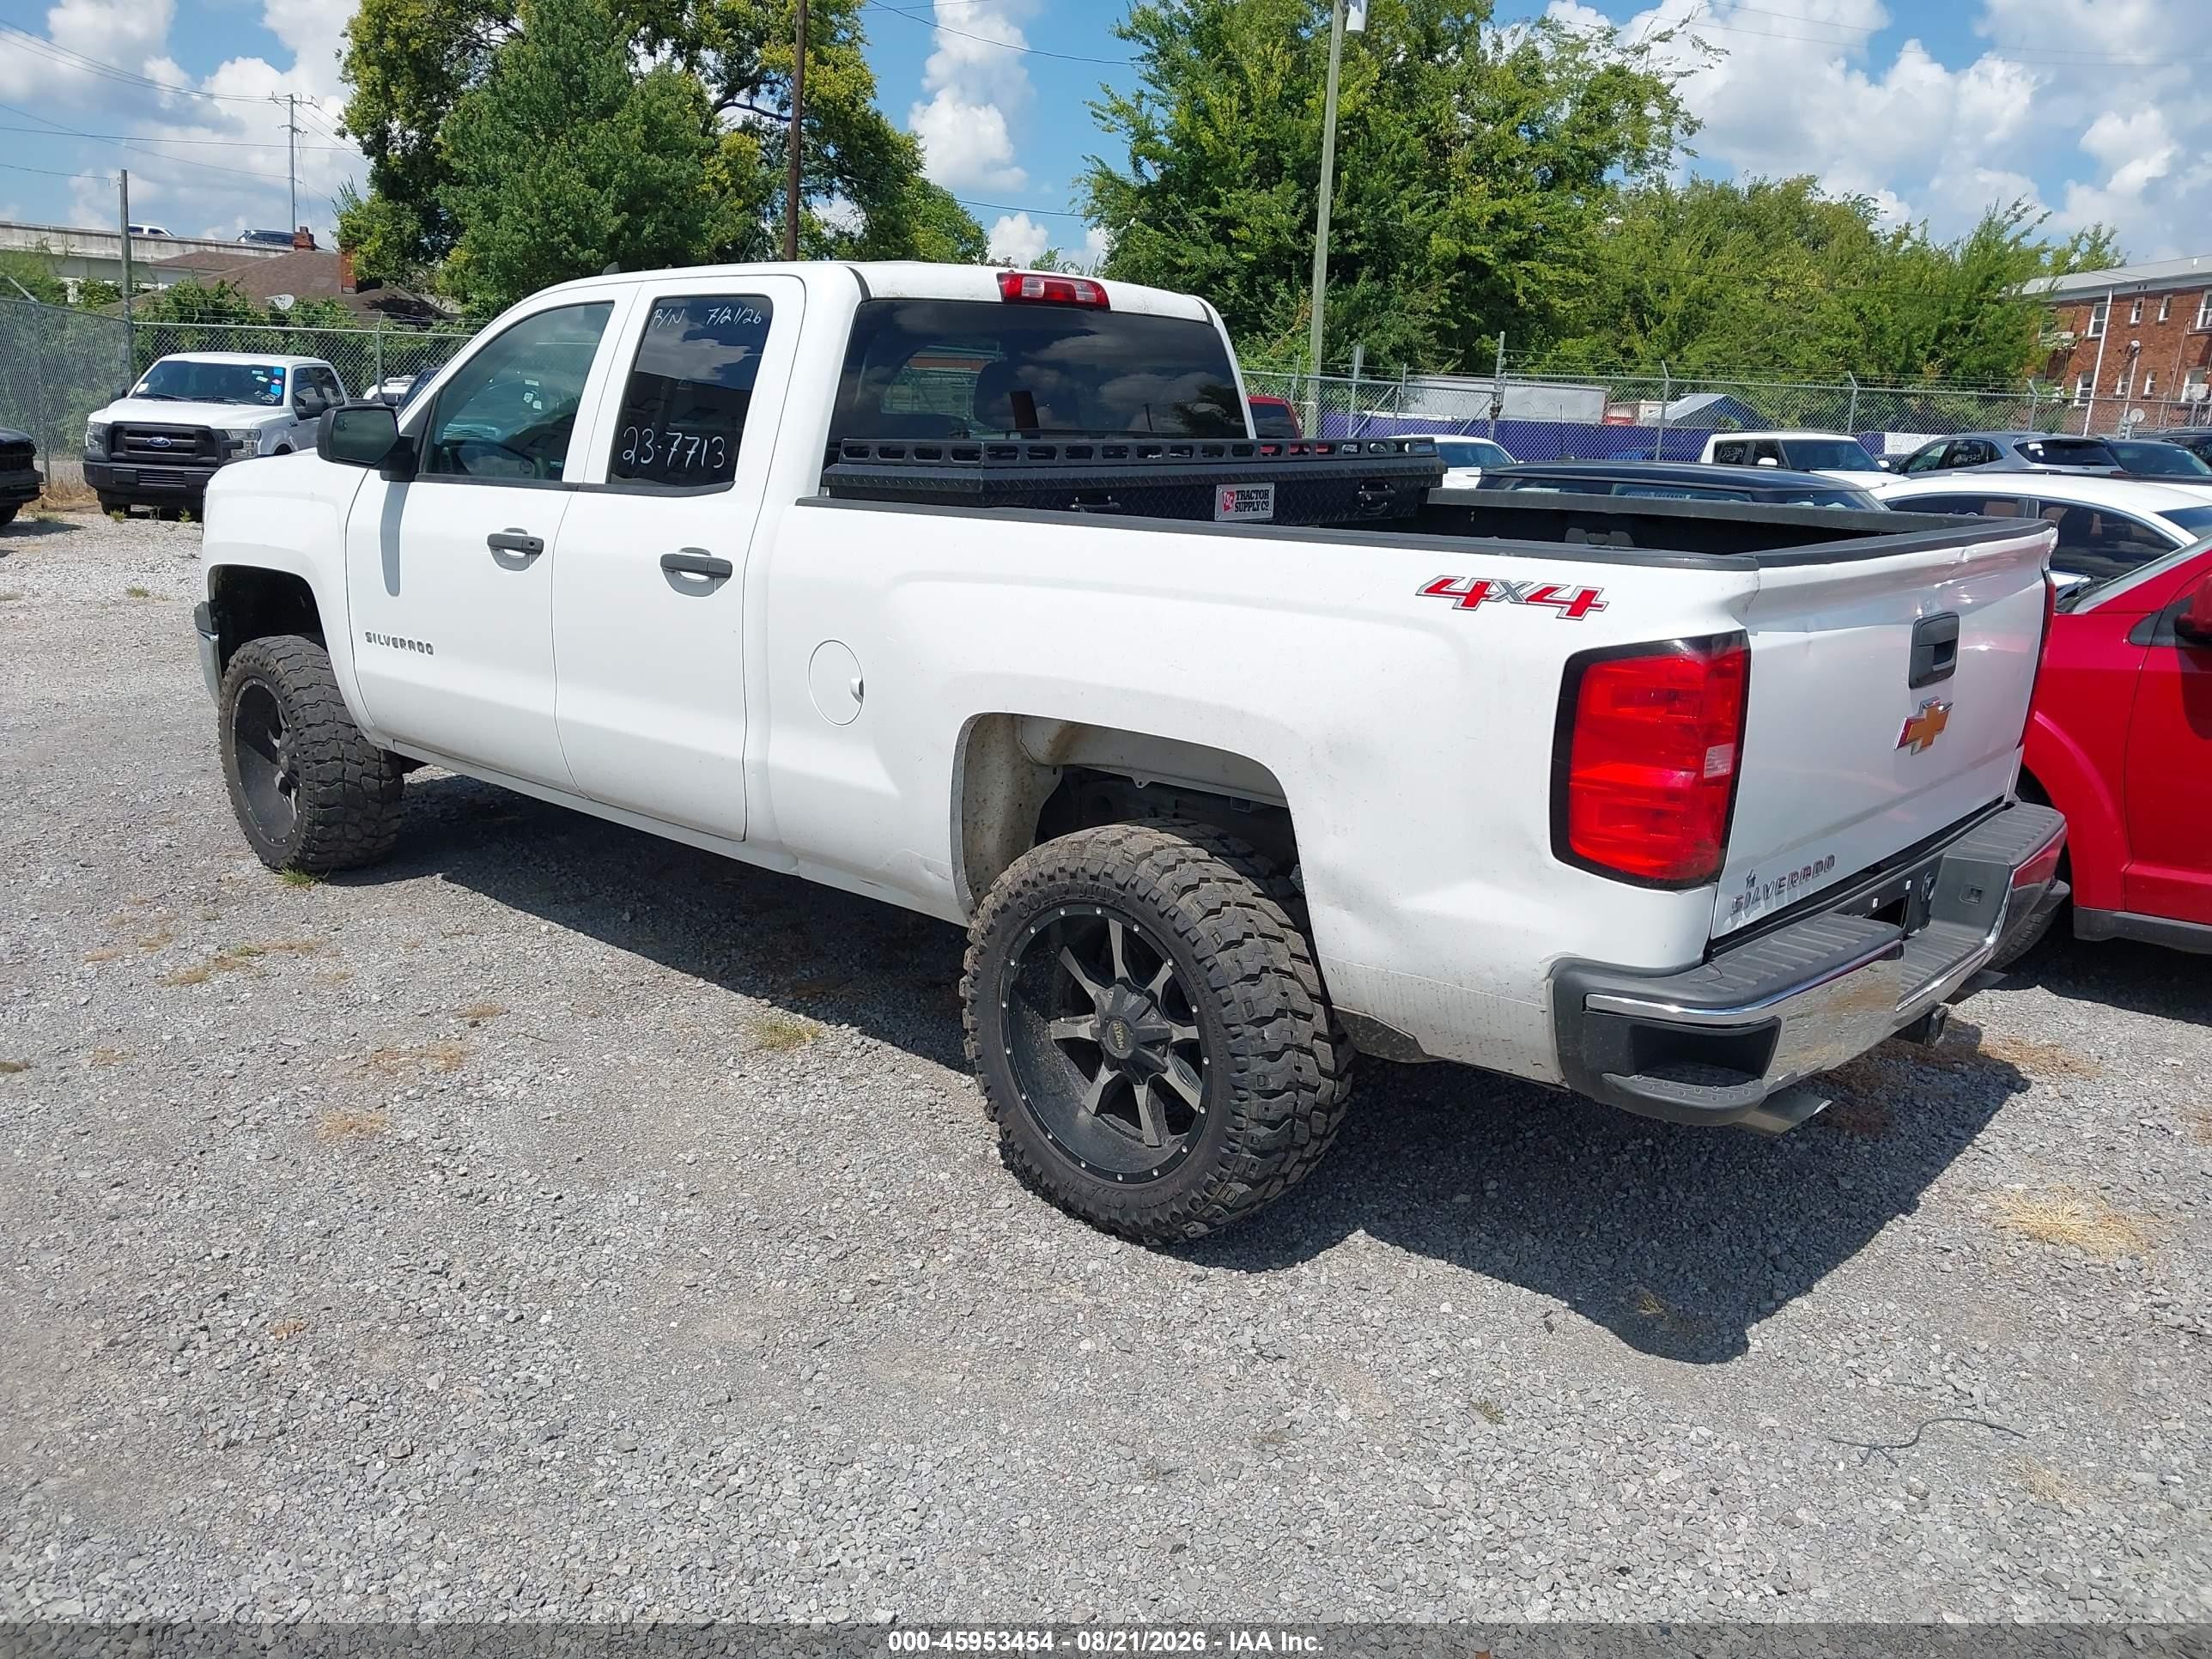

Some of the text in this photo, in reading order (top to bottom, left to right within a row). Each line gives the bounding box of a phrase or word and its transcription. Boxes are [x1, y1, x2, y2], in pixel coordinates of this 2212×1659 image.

[622, 426, 726, 469] 23-7713
[1234, 501, 1261, 513] SUPPLY
[1236, 489, 1270, 501] TRACTOR
[364, 631, 434, 655] SILVERADO
[1731, 854, 1836, 915] SILVERADO
